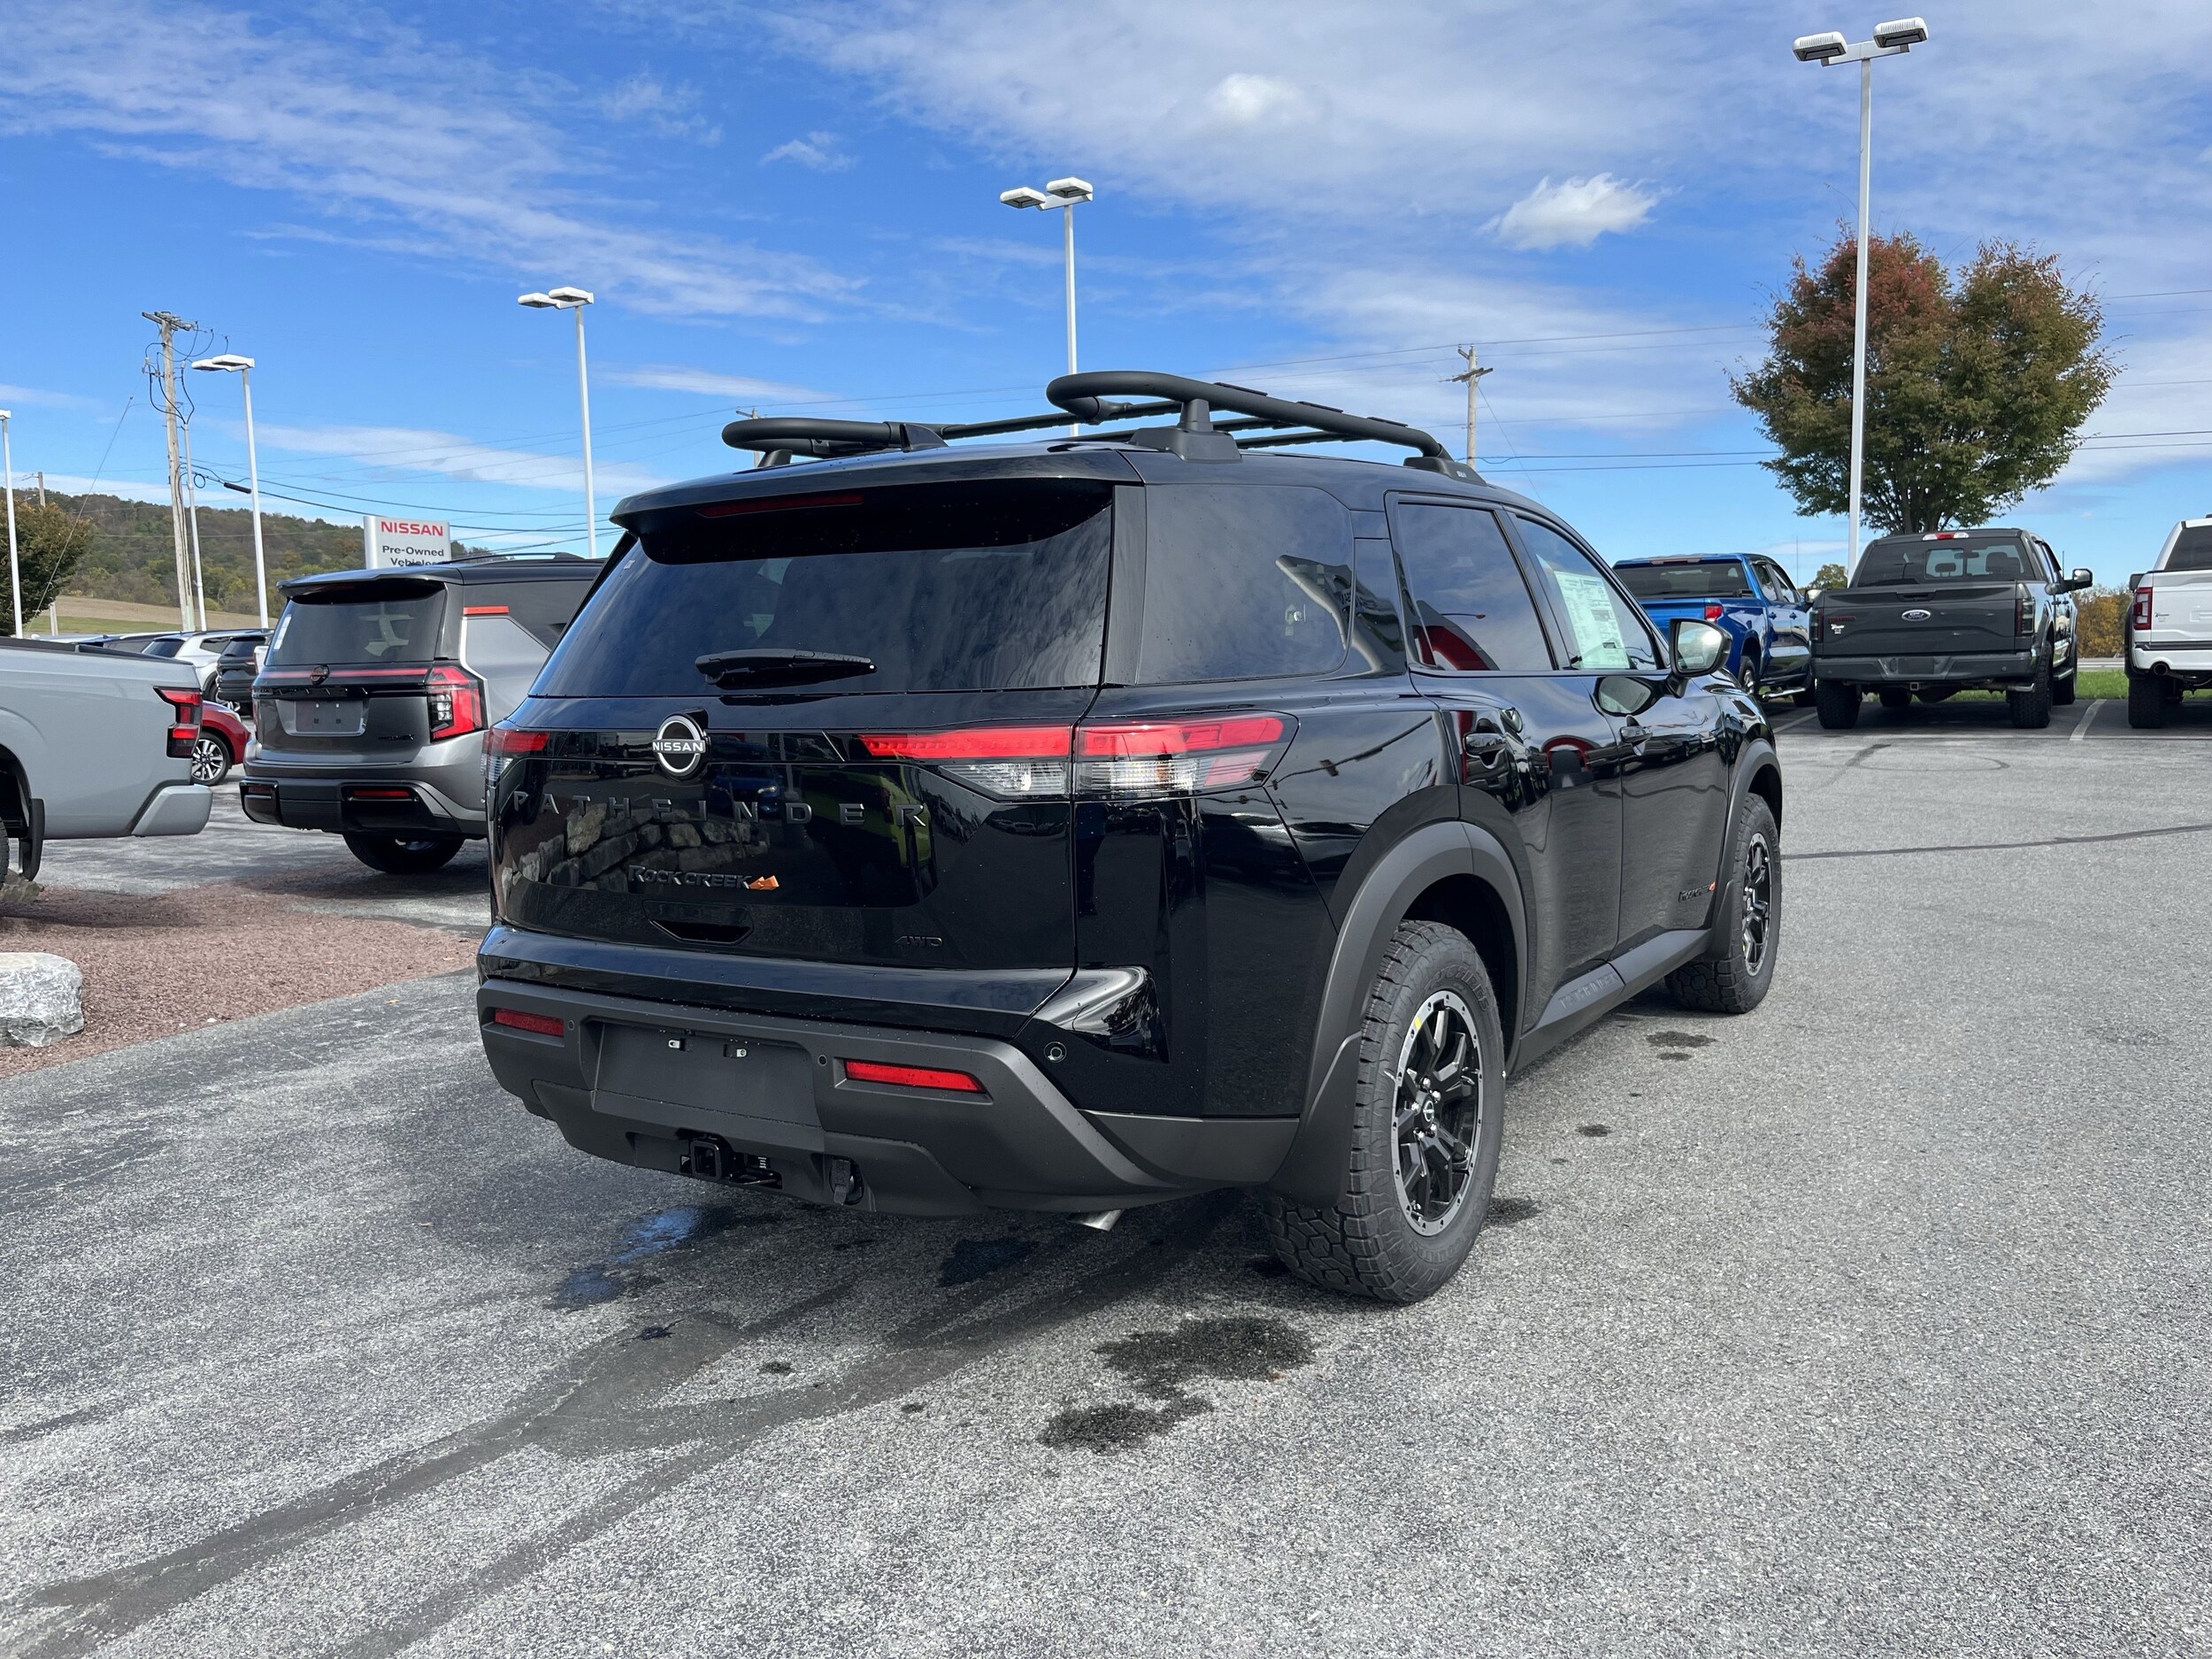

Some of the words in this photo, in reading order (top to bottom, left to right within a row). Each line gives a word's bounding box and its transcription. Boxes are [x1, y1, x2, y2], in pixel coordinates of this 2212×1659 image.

[380, 520, 443, 537] NISSAN
[382, 545, 444, 557] Pre-Owned
[652, 741, 703, 752] NISSAN
[513, 790, 927, 827] PATHFINDER
[628, 864, 682, 886] ROCK
[685, 872, 752, 890] CREEK
